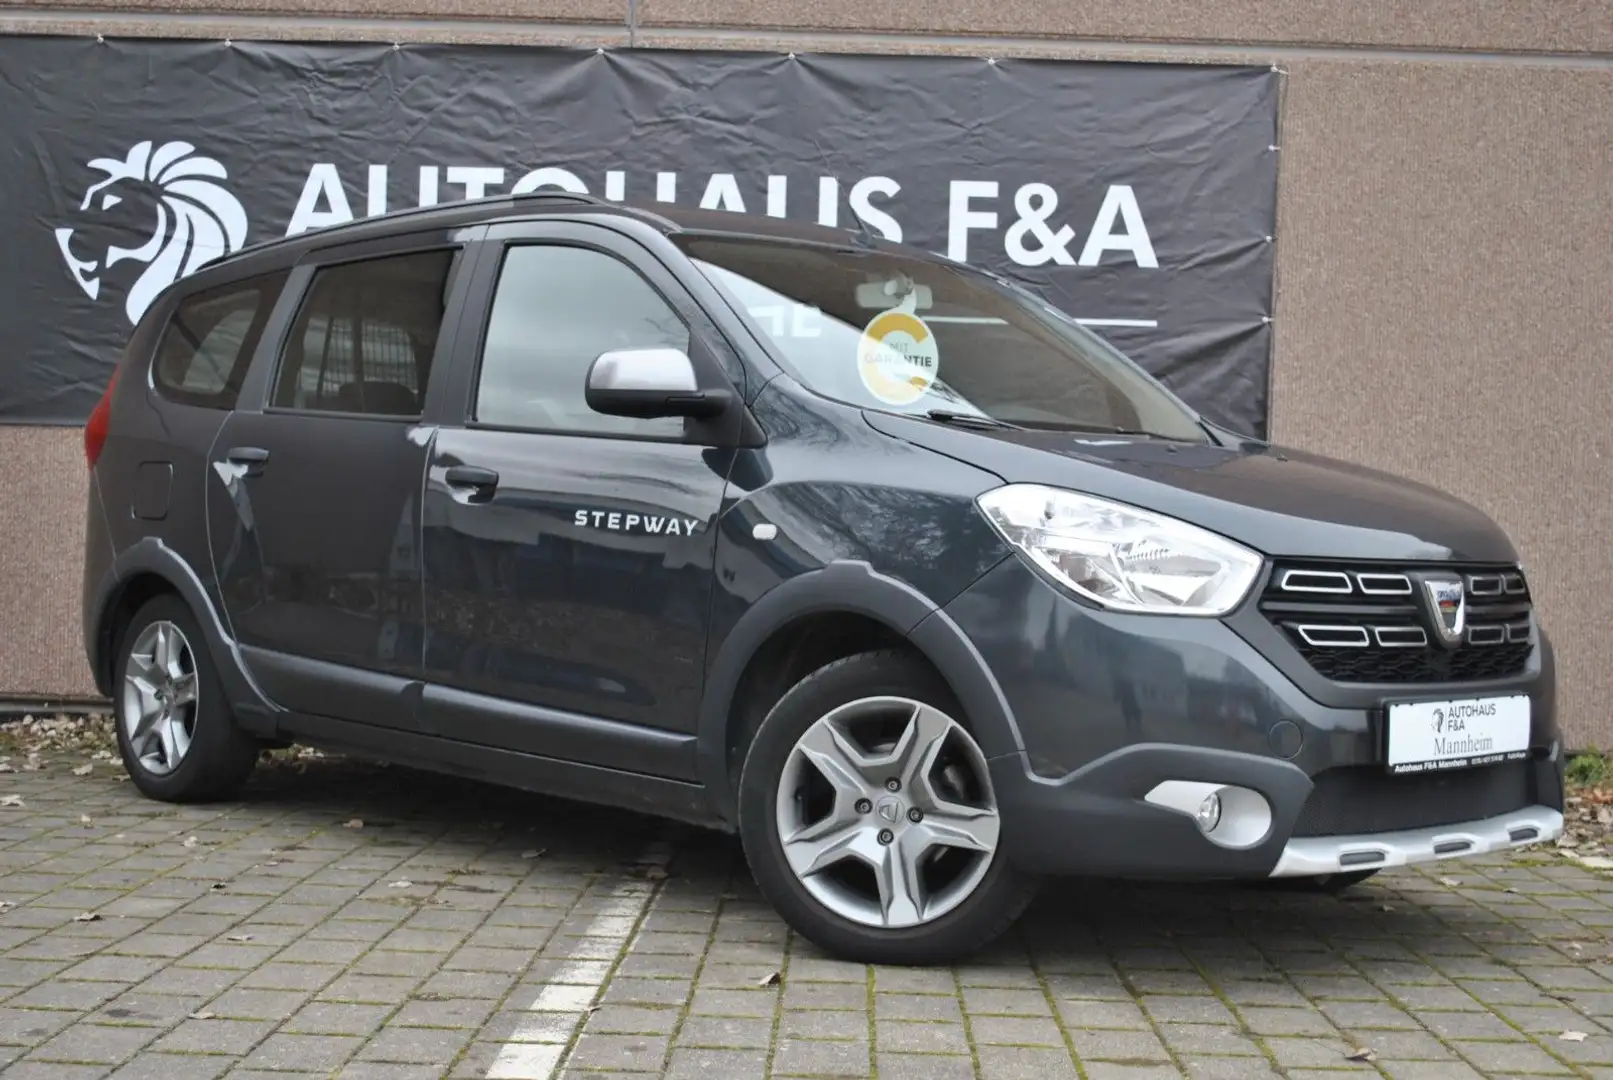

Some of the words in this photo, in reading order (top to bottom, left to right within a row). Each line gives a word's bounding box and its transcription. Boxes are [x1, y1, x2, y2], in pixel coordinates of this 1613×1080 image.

[947, 180, 1160, 269] F&A
[574, 509, 699, 537] STEPWAY
[1448, 704, 1497, 718] AUTOHAUS
[1447, 719, 1465, 732] F&A
[1434, 733, 1494, 756] Mannheim
